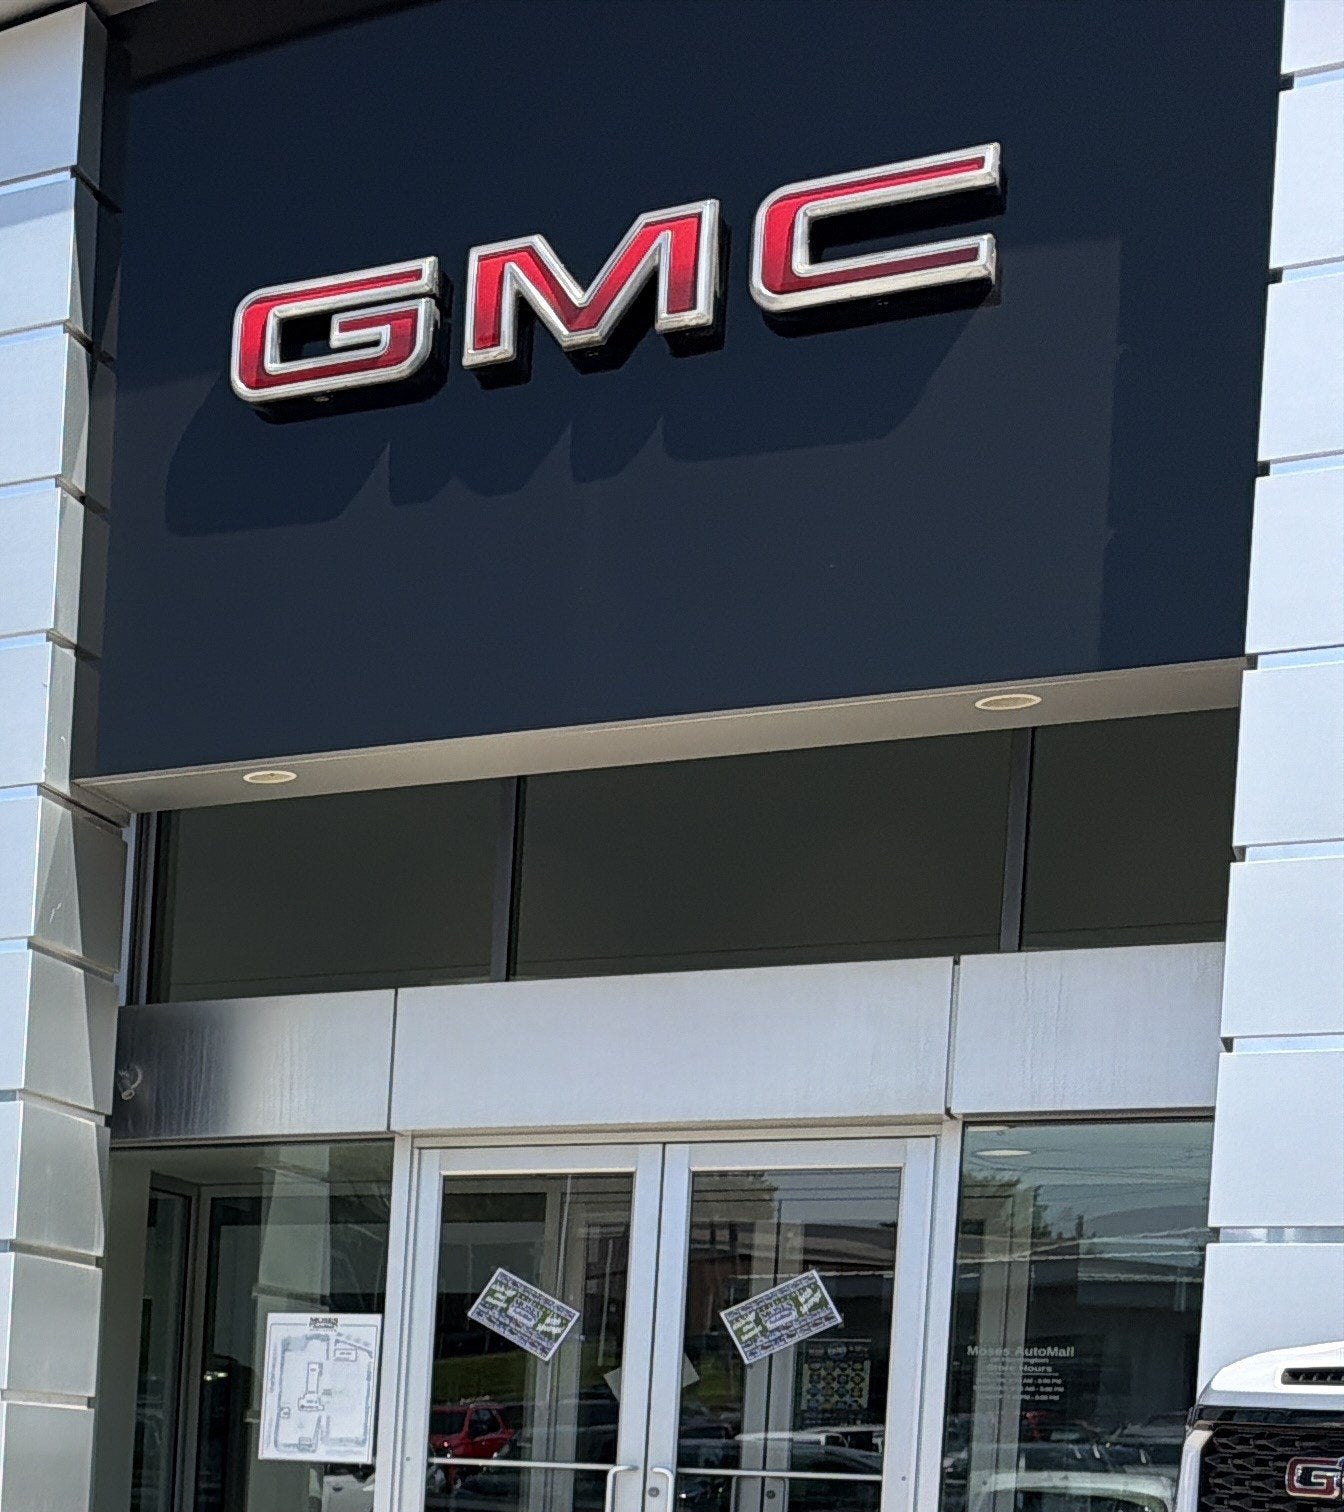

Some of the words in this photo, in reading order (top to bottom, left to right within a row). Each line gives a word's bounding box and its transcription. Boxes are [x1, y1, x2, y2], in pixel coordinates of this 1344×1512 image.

[231, 142, 1000, 402] GMC
[967, 1345, 1010, 1356] Moses
[1014, 1346, 1075, 1358] AutoMall
